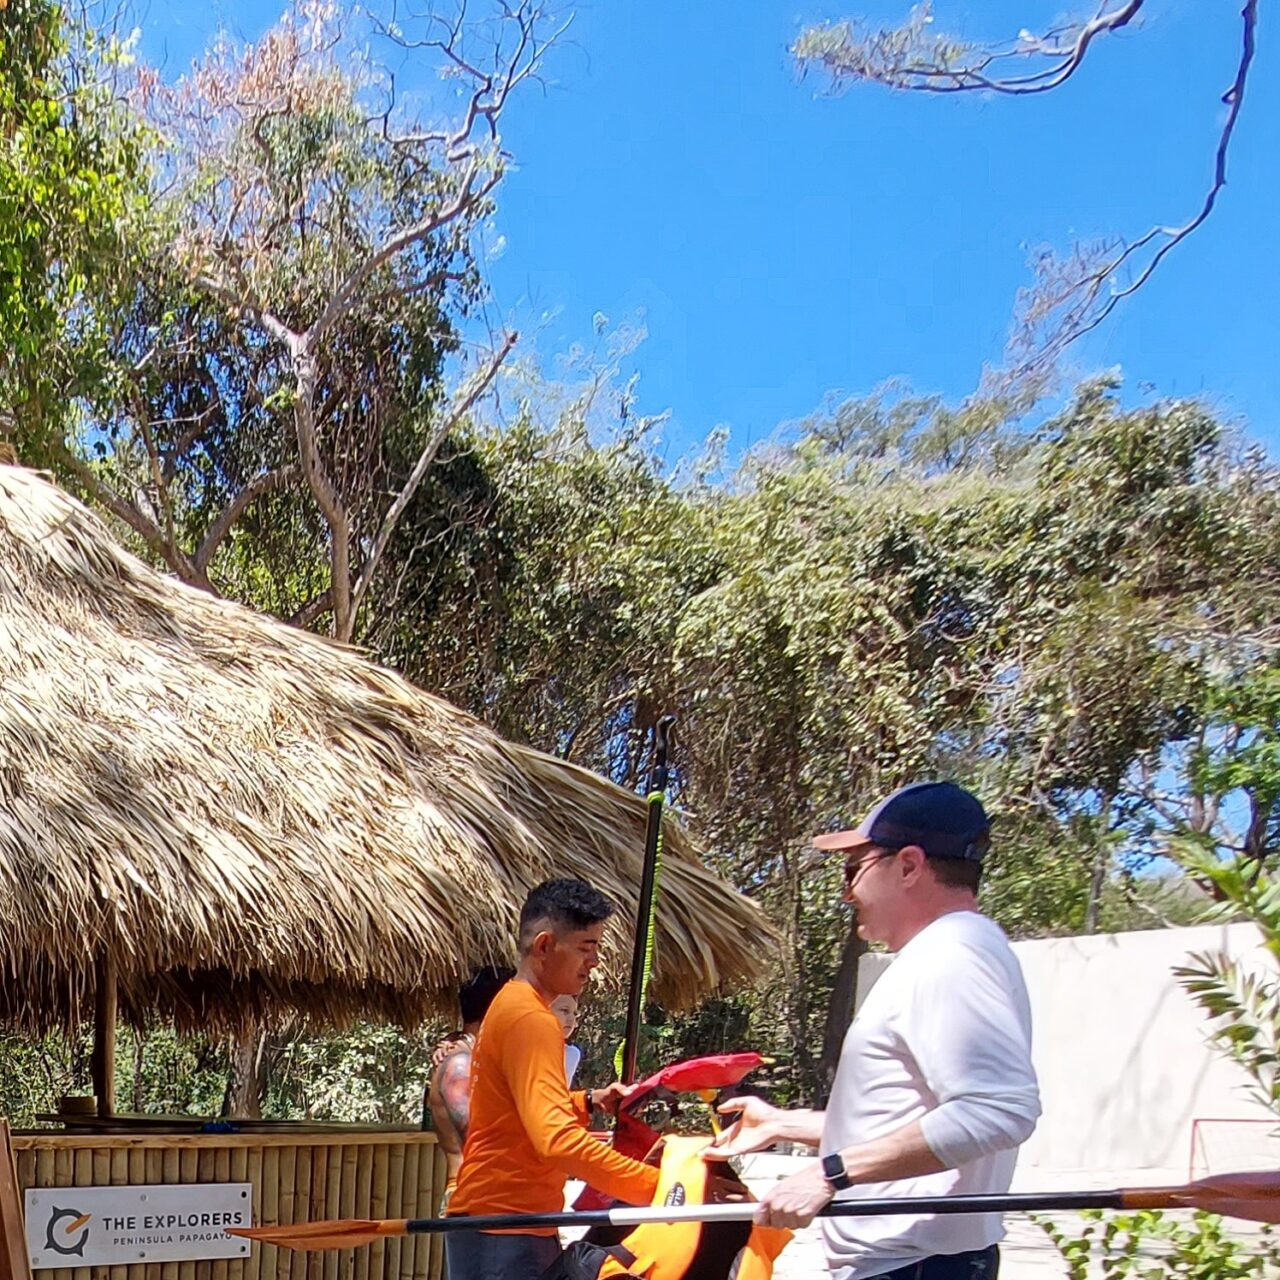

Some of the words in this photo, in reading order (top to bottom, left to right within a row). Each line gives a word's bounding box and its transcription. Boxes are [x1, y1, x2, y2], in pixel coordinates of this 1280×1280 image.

[102, 1217, 136, 1231] THE
[144, 1212, 243, 1229] EXPLORERS
[113, 1236, 173, 1245] PENINSULA
[179, 1232, 233, 1242] PAPAGAYO
